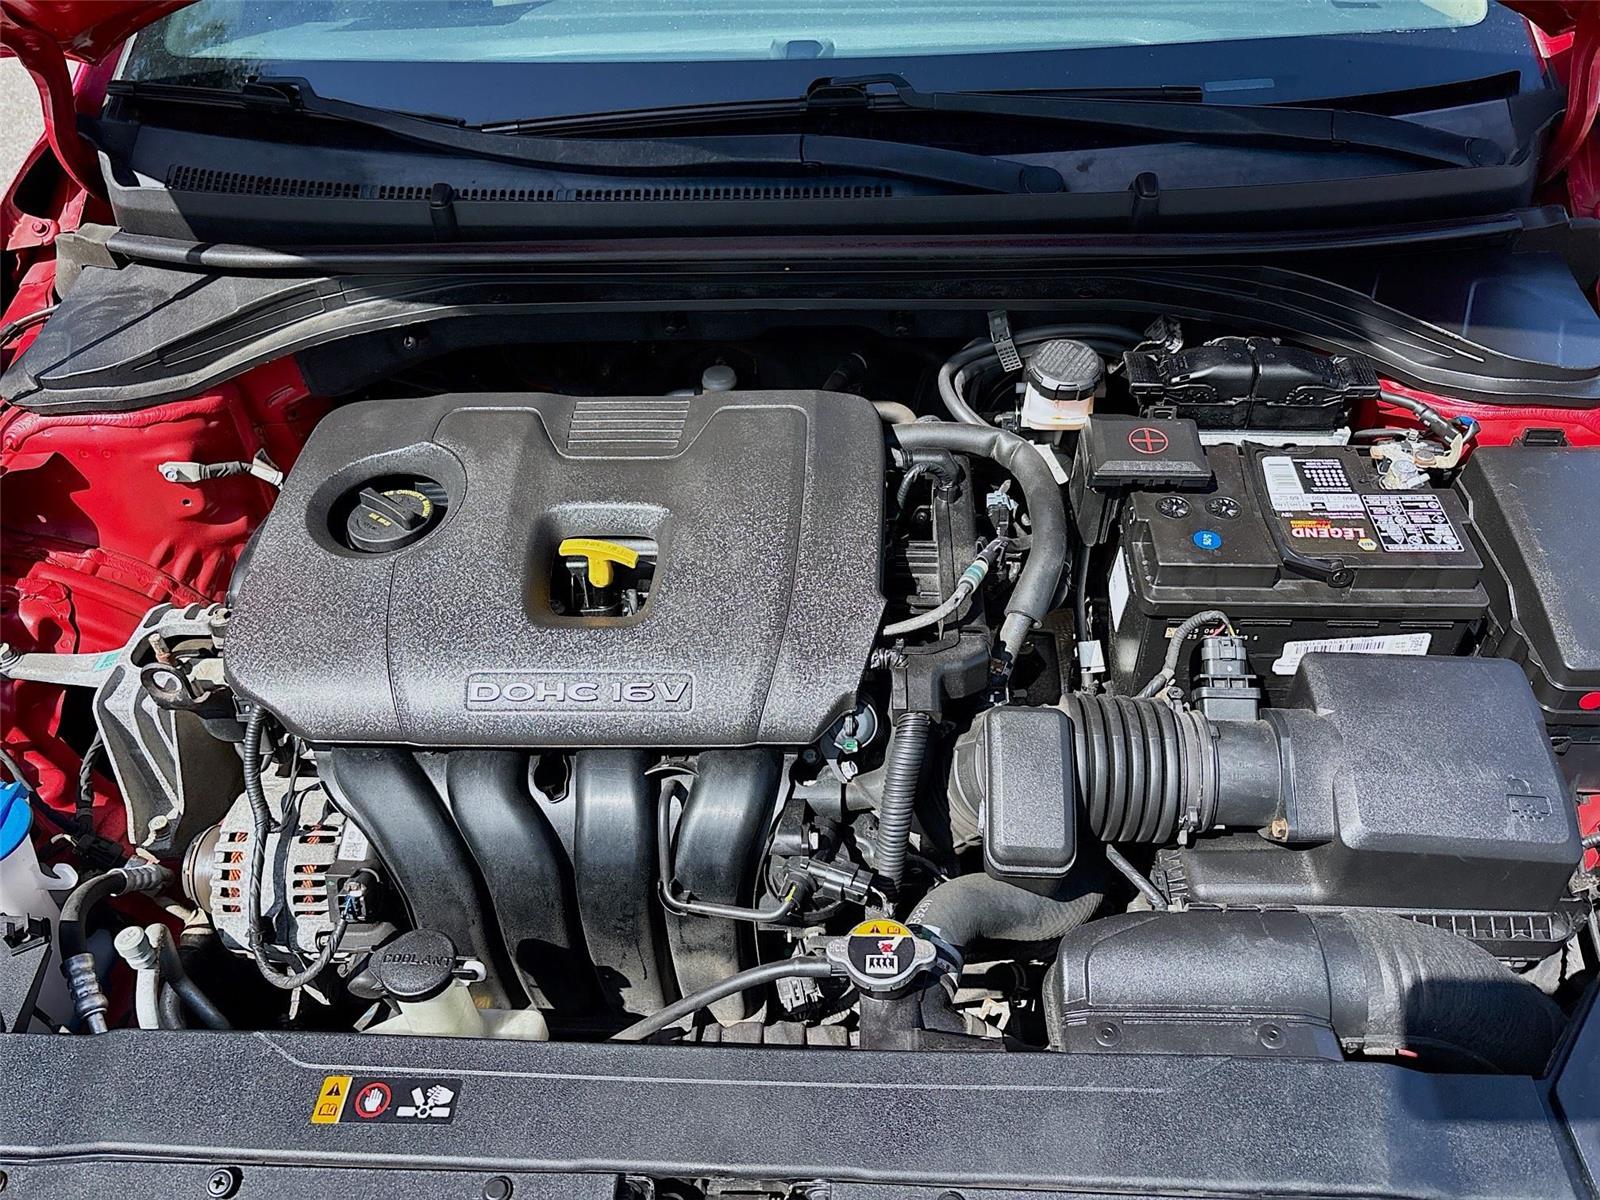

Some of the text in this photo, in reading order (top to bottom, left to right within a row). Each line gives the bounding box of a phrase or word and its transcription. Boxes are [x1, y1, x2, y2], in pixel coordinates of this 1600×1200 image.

[1291, 527, 1366, 538] LEGEND
[469, 681, 689, 703] DOHC 16V
[382, 953, 454, 968] COOLANT
